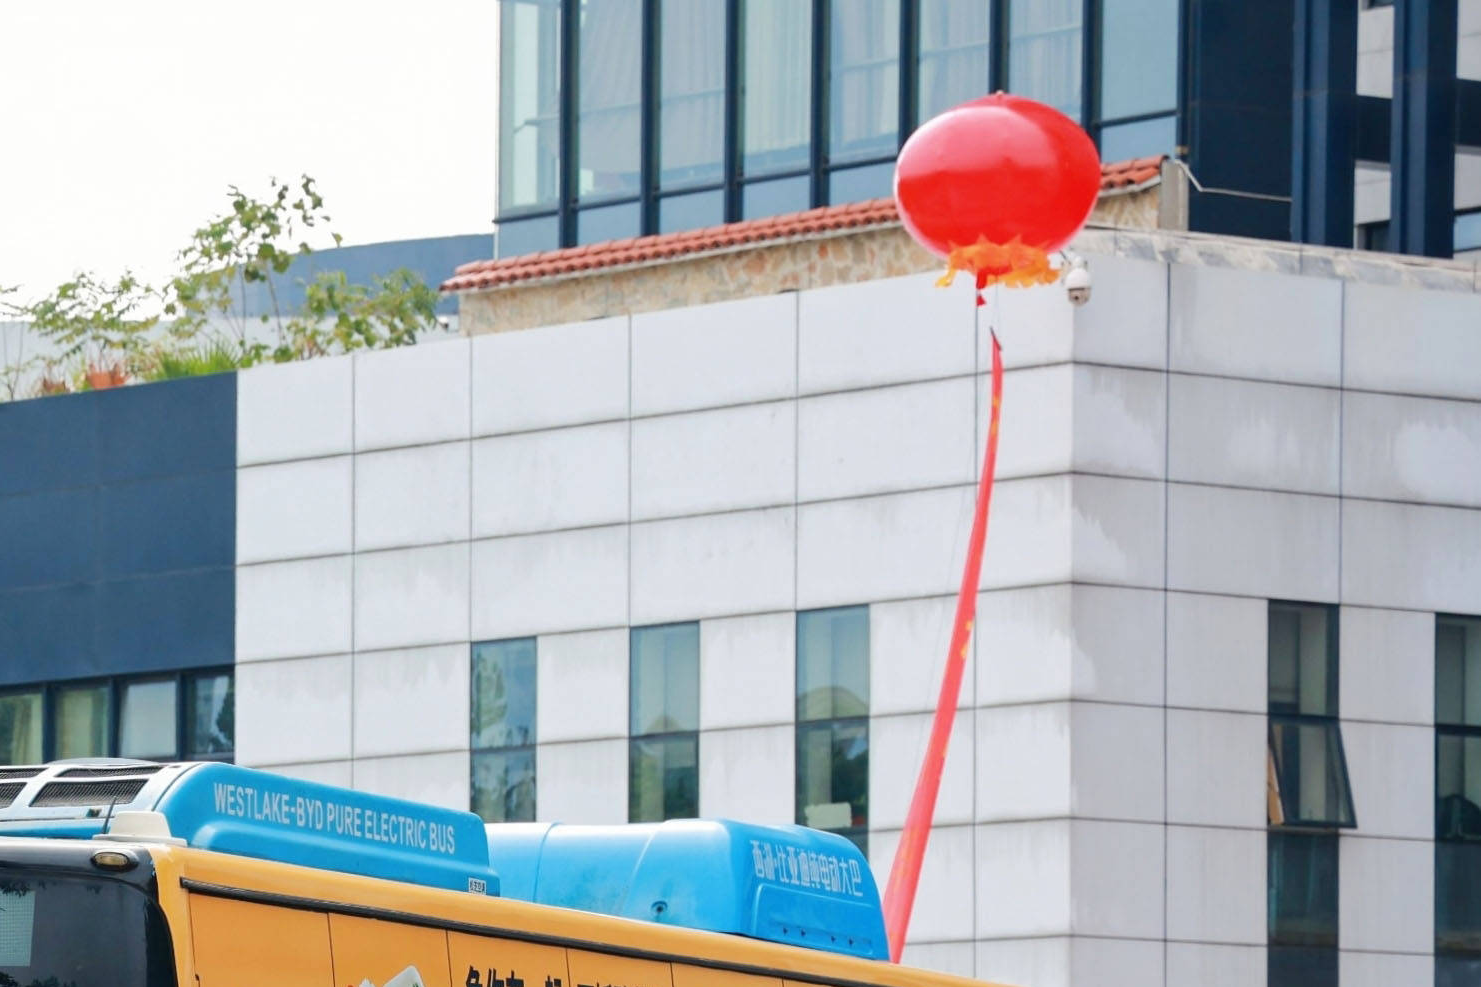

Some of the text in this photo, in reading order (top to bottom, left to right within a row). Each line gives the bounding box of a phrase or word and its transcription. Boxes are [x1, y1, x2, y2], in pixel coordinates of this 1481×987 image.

[213, 782, 456, 855] WESTLAKE-BYD PURE ELECTRIC BUS
